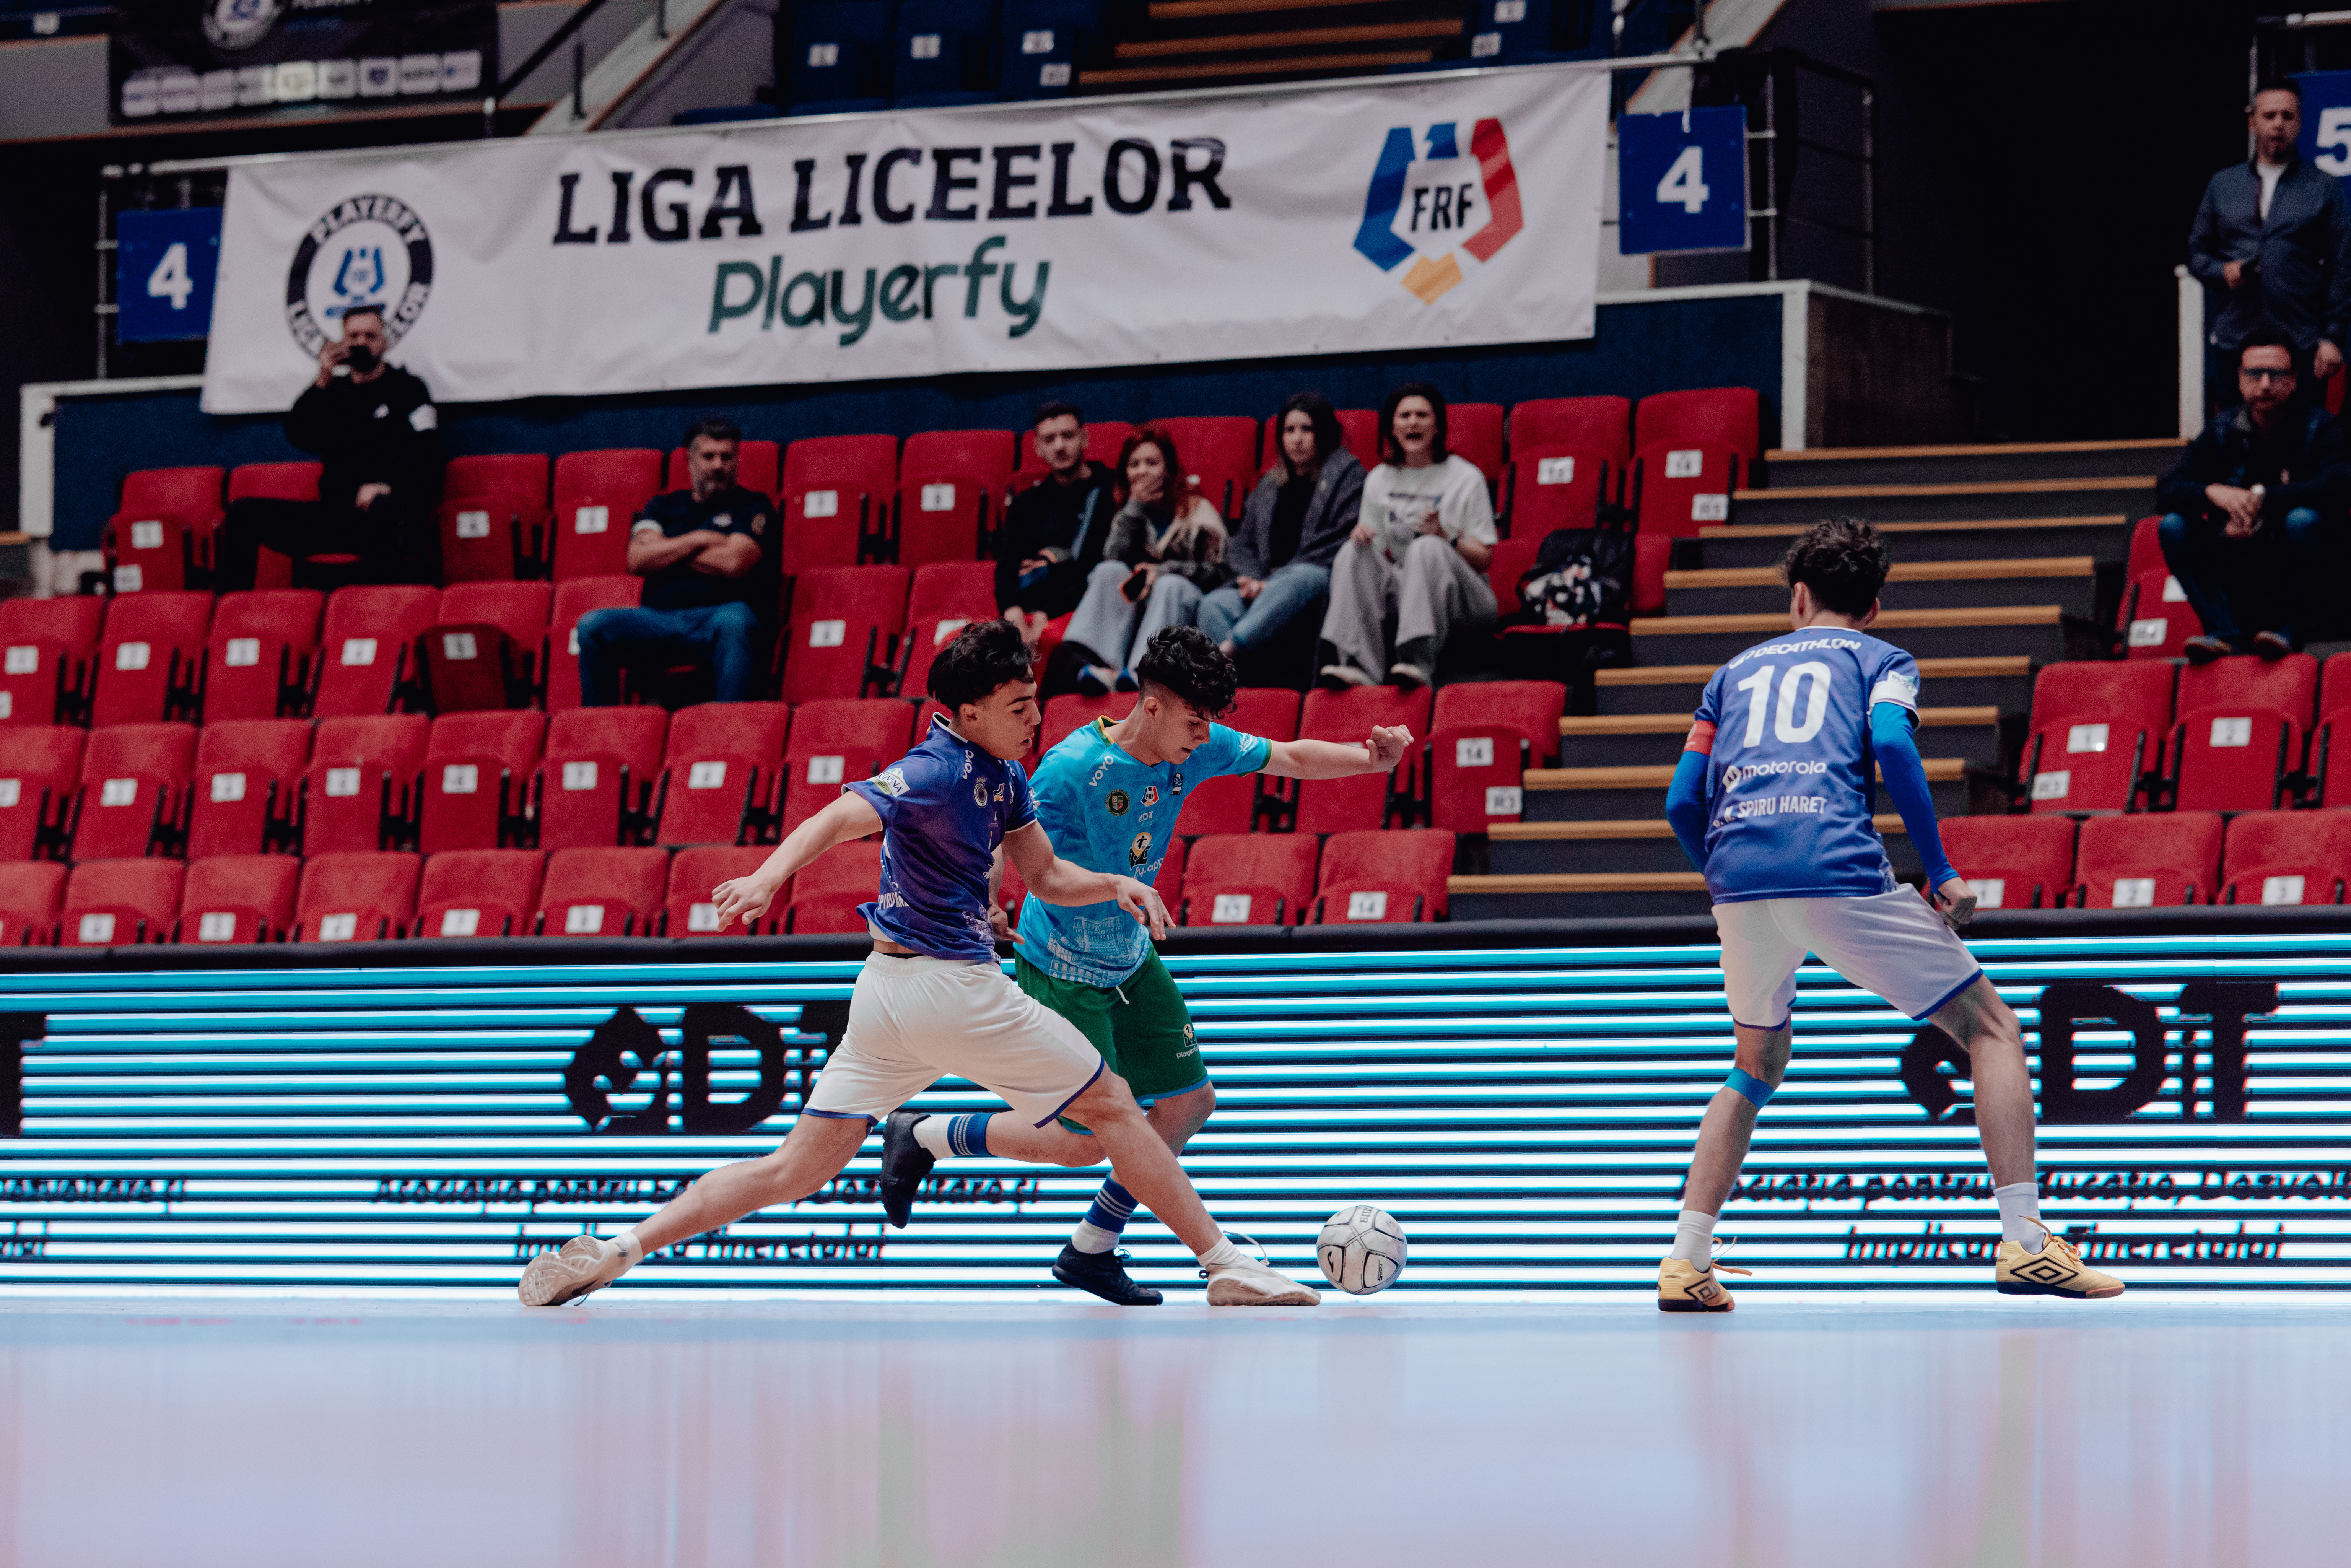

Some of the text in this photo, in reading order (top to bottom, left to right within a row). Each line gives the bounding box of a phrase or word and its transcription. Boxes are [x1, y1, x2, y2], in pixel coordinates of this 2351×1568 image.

[2314, 106, 2351, 177] 5
[553, 137, 1231, 245] LIGA LICEELOR
[1411, 183, 1473, 232] FRF
[1656, 146, 1709, 213] 4
[148, 242, 192, 310] 4
[706, 236, 1051, 346] Playerfy
[1753, 638, 1862, 658] DECATHLON
[1738, 661, 1831, 748] 10
[962, 750, 974, 779] VOYO
[1089, 756, 1114, 786] VOYO
[1743, 760, 1827, 779] motorola
[1737, 797, 1776, 818] SPIRU
[1779, 796, 1827, 814] HARET
